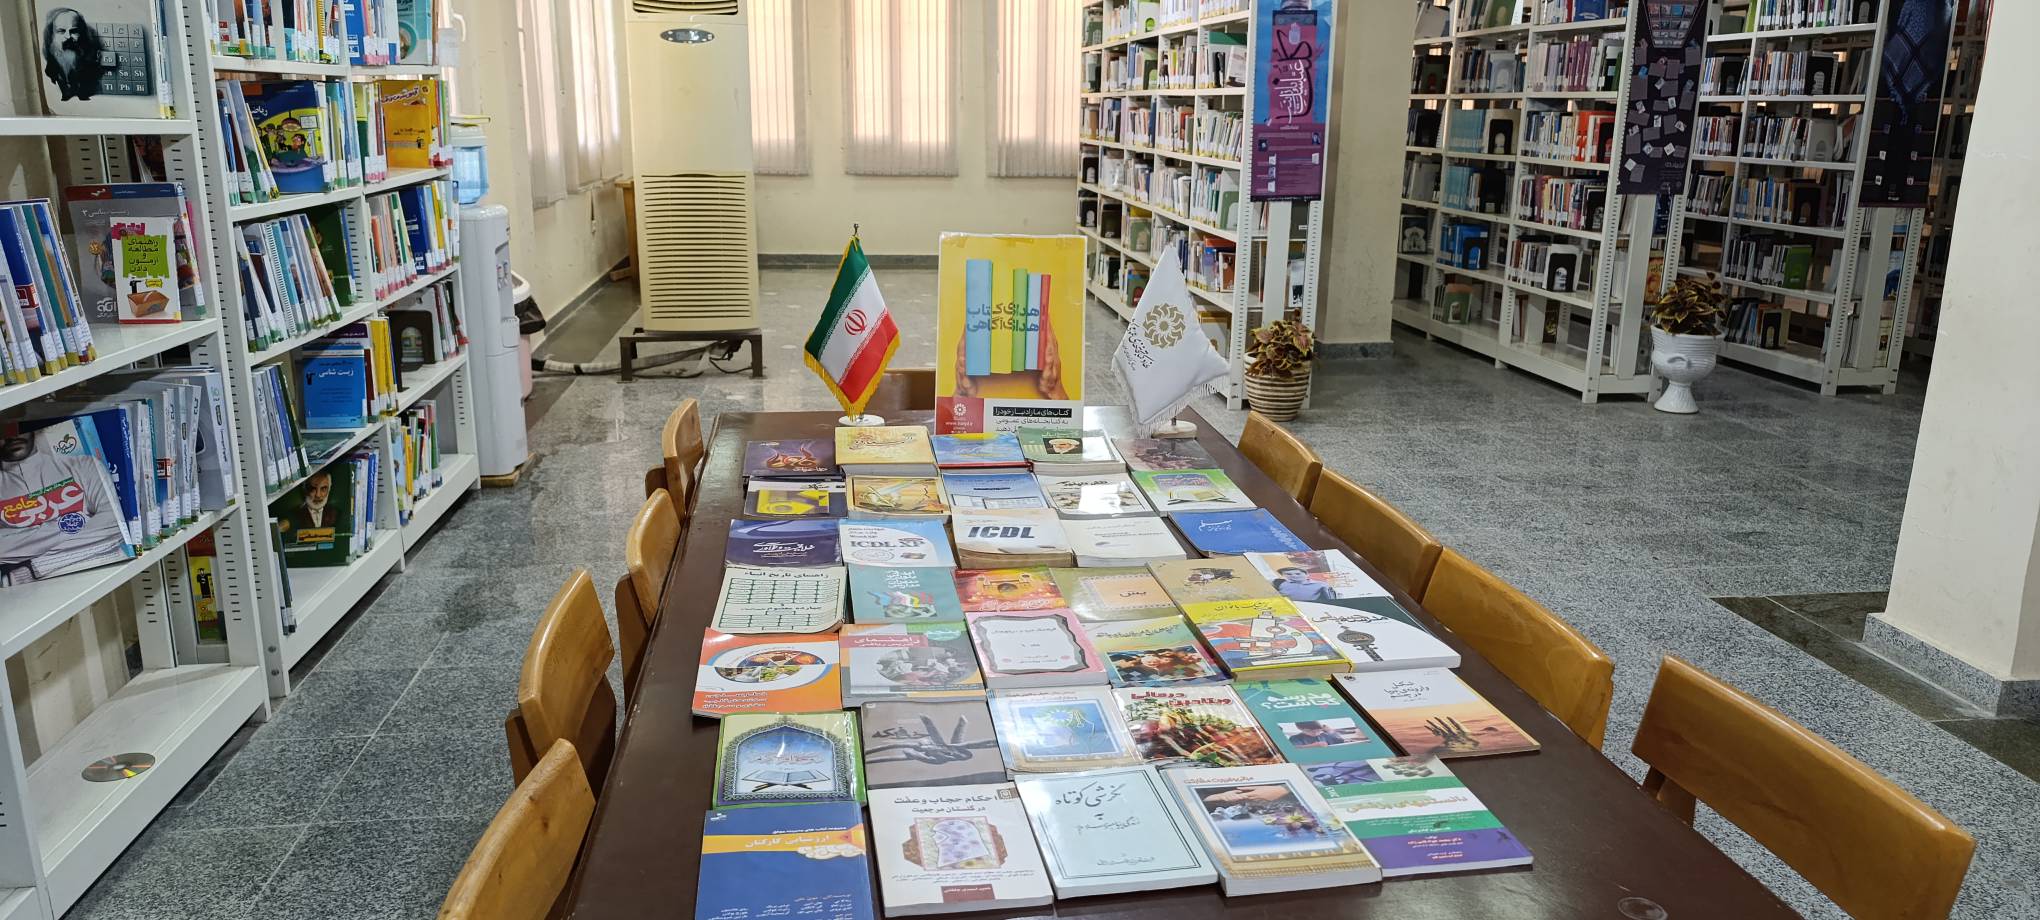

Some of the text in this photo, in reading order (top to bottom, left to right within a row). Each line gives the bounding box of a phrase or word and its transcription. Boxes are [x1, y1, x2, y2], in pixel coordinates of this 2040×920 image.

[967, 302, 1046, 318] اهدای کتاب
[966, 316, 1046, 332] اهدای آگاهی
[1, 482, 85, 529] عربی
[4, 496, 38, 518] جامع
[968, 526, 1035, 539] ICDL
[898, 540, 926, 548] XP
[1267, 692, 1333, 701] مدرسه
[1055, 781, 1127, 808] نگرشی کوتاه
[745, 836, 781, 848] کارکنان
